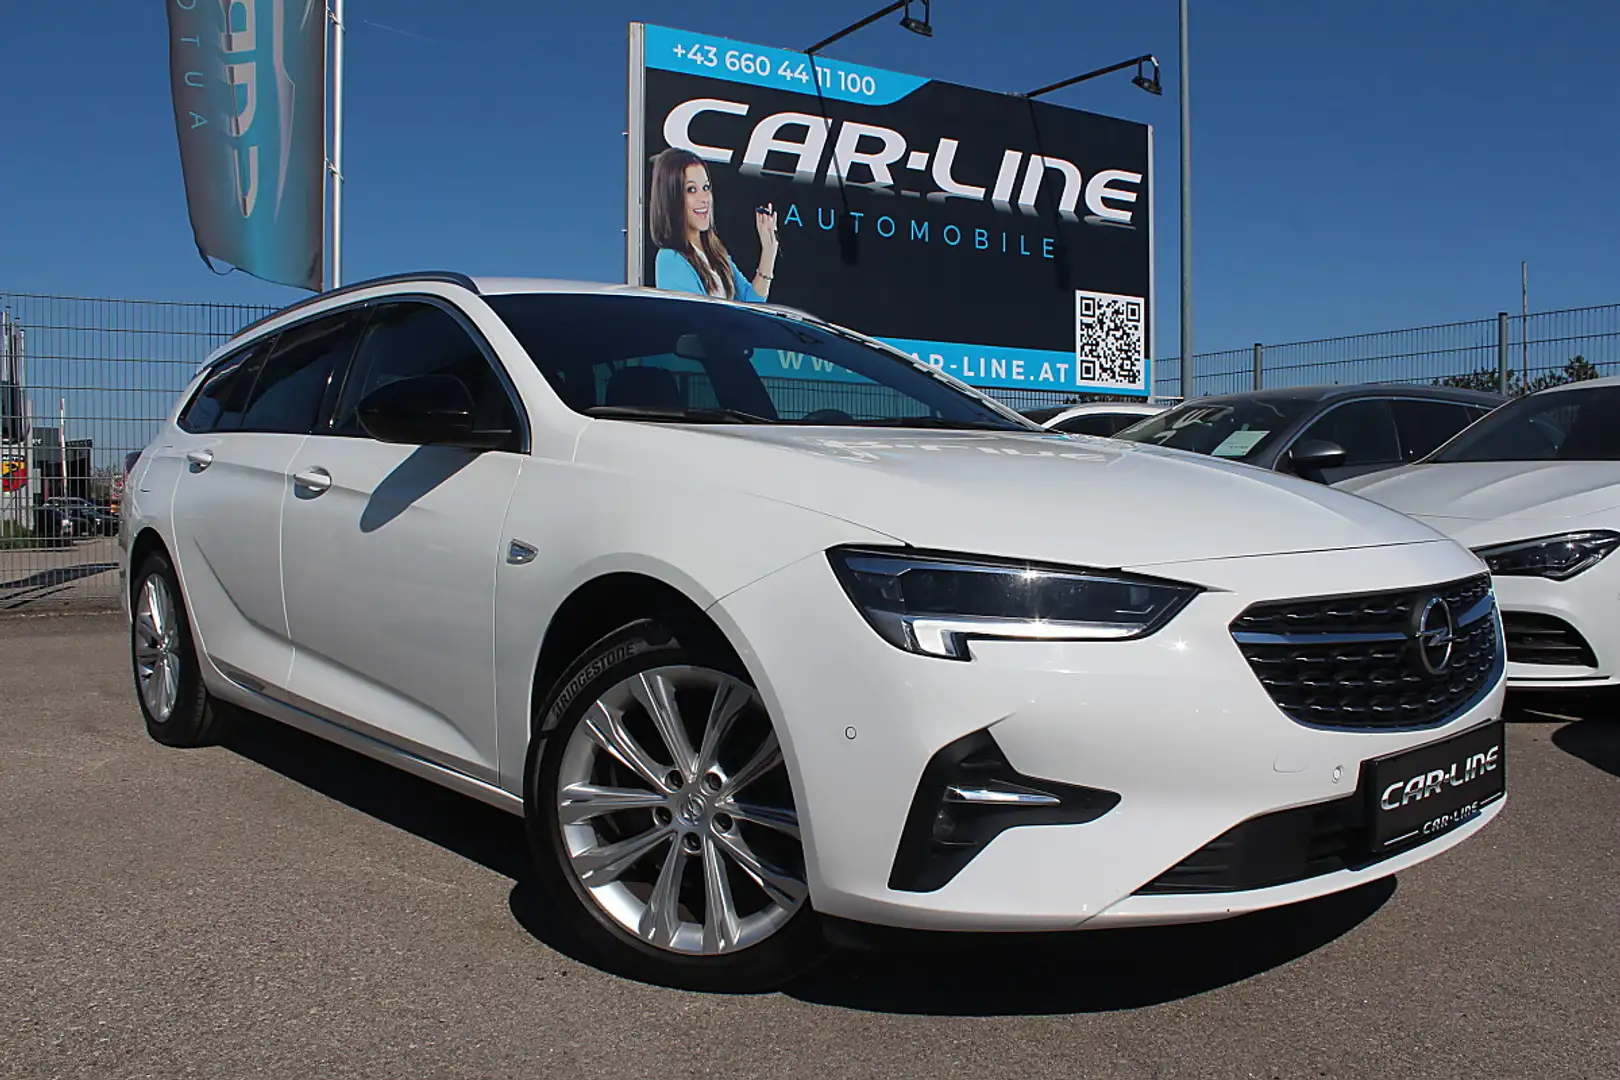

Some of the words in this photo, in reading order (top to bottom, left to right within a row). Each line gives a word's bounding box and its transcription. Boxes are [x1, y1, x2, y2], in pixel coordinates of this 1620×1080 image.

[673, 43, 718, 67] +43
[725, 50, 770, 76] 660
[777, 60, 809, 83] 44
[816, 66, 831, 88] 11
[837, 71, 876, 95] 100
[784, 204, 1055, 258] AUTOMOBILE
[551, 641, 636, 719] BRIDGESTONE
